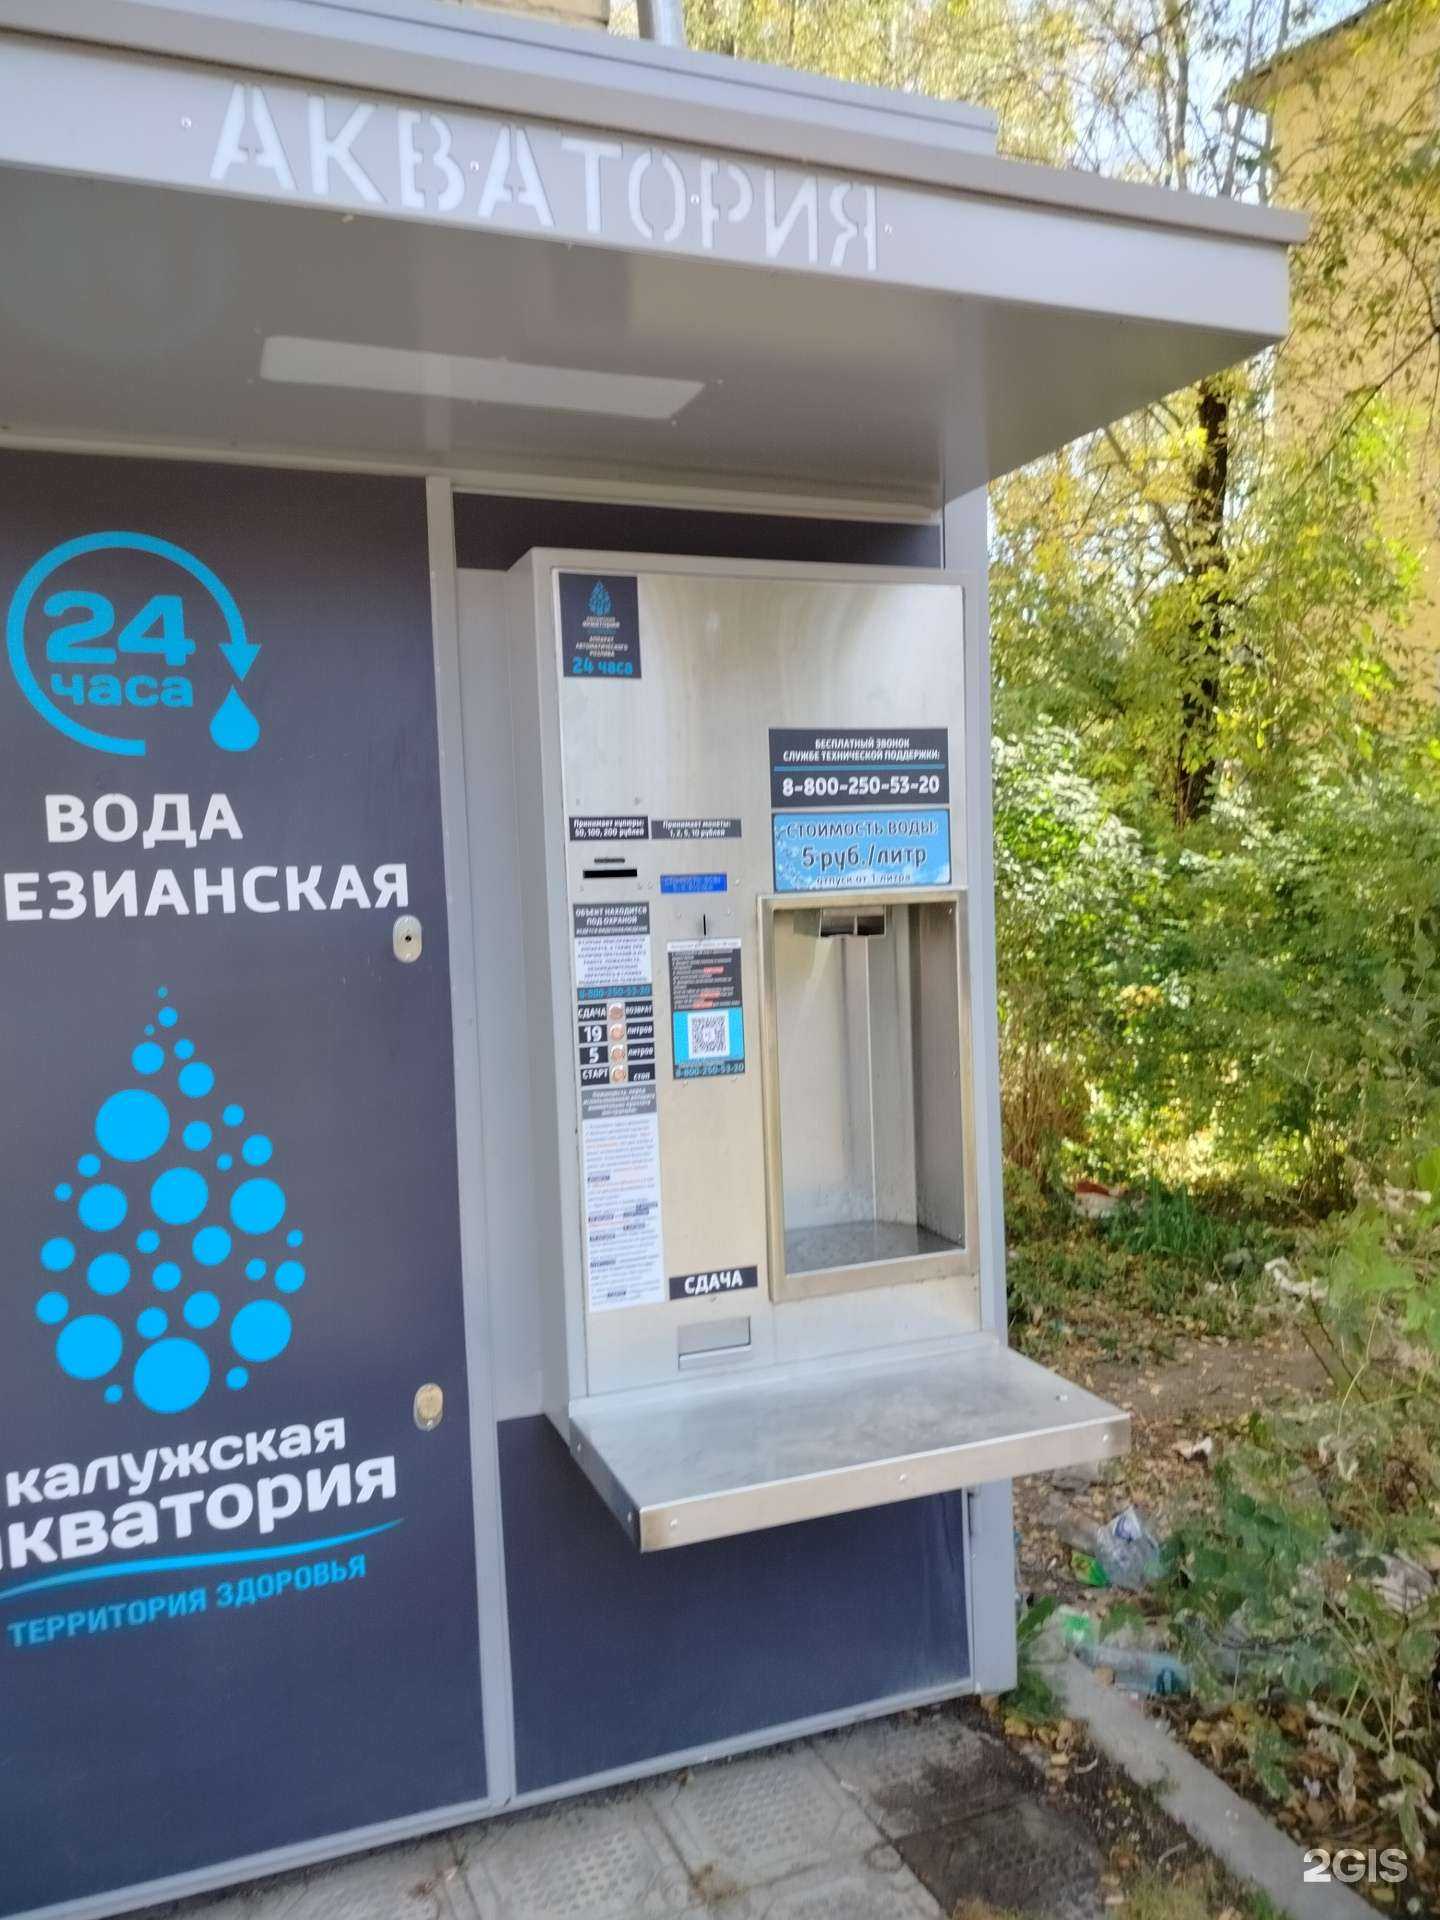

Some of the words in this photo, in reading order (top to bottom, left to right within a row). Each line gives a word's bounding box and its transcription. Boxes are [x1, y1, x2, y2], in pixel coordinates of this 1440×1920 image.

[209, 81, 877, 272] АКВАТОРИЯ
[43, 591, 196, 666] 24
[51, 674, 194, 707] часа
[783, 750, 820, 762] СЛУЖБЕ
[822, 749, 883, 762] ТЕХНИЧЕСКОЙ
[815, 737, 873, 750] БЕСПЛАТНЫЙ
[876, 738, 910, 749] ЗВОНОК
[782, 775, 940, 797] 8-800-250-53-20
[45, 793, 243, 849] ВОДА
[574, 818, 613, 829] Принимает
[802, 846, 815, 867] 5
[4, 864, 409, 921] ЕЗИАНСКАЯ
[577, 1008, 607, 1019] СДАЧА
[584, 1026, 602, 1042] 19
[589, 1046, 599, 1063] 5
[582, 1067, 608, 1080] СТАРТ
[684, 1269, 744, 1296] СДАЧА
[6, 1417, 346, 1507] калужская
[0, 1455, 397, 1569] кватория
[8, 1588, 207, 1647] ТЕРРИТОРИЯ
[216, 1553, 367, 1609] ЗДОРОВЬЯ
